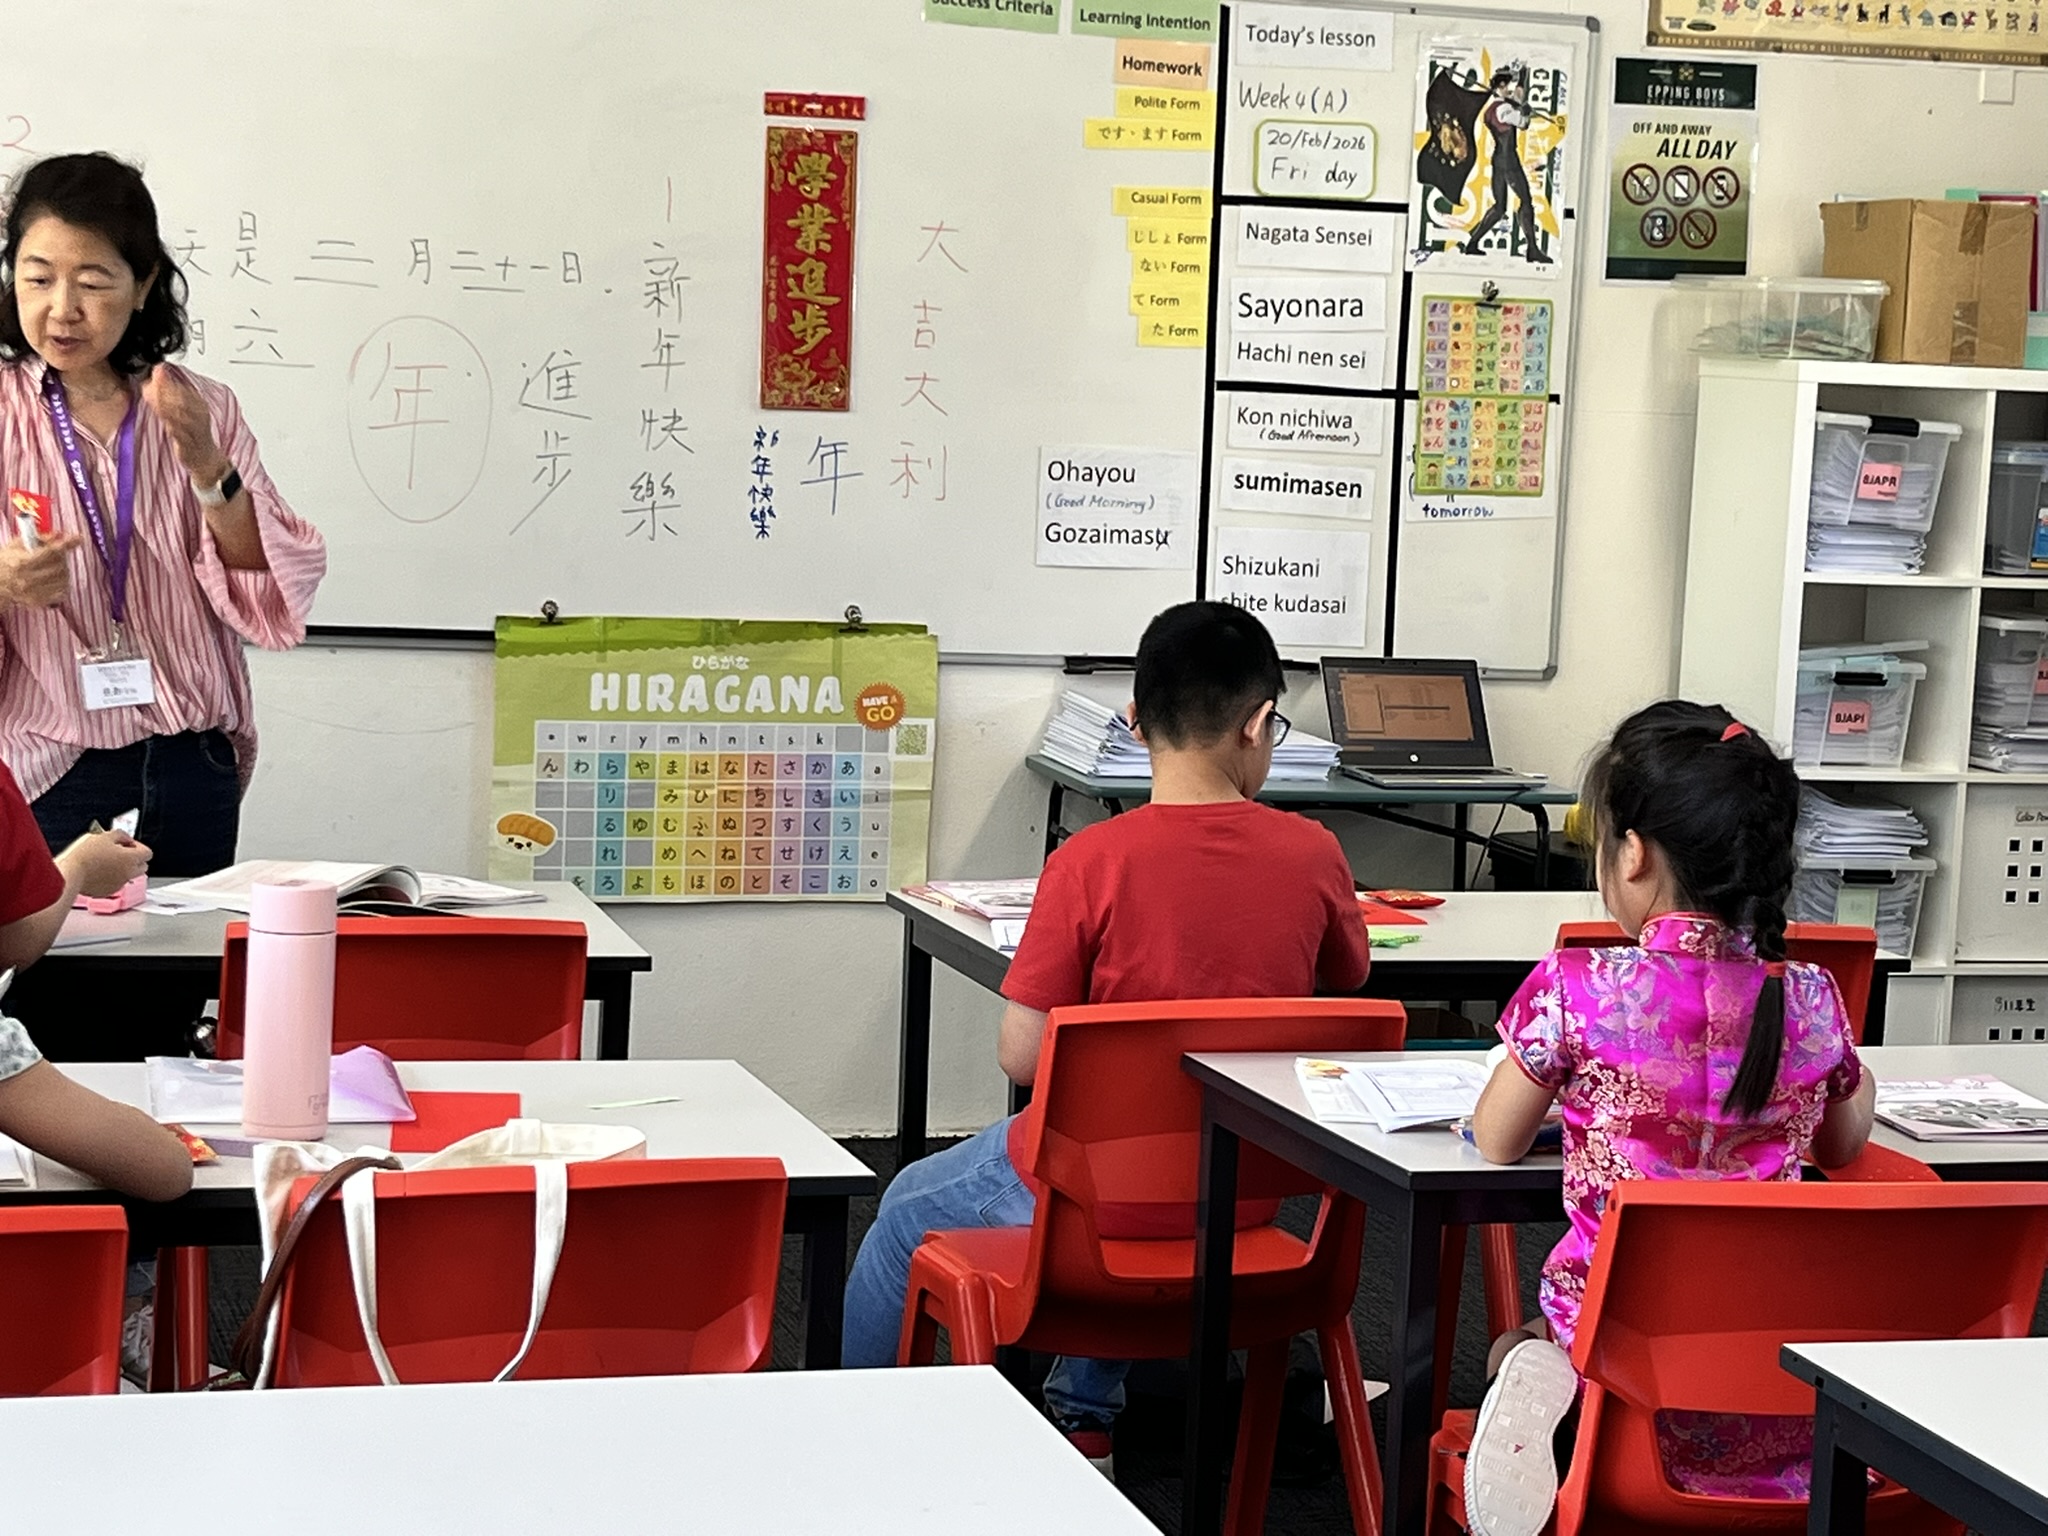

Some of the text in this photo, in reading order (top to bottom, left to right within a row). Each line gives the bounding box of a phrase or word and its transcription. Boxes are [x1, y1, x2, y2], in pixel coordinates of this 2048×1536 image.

[931, 0, 1054, 16] uccess Criteria
[1080, 9, 1210, 30] Learning Intention
[1246, 25, 1375, 47] Today's lesson
[1123, 56, 1202, 76] Homework
[1135, 96, 1200, 109] Polite Form
[1240, 81, 1289, 108] Week
[1296, 92, 1305, 109] 4
[1648, 84, 1725, 101] EPPING BOYS
[1099, 126, 1201, 140] です・ます Form
[1633, 122, 1713, 137] OFF AND AWAY
[1268, 130, 1365, 150] 20/Feb/2026
[1656, 138, 1738, 161] ALL DAY
[1272, 157, 1356, 188] Fri day
[1131, 192, 1201, 204] Casual Form
[1135, 231, 1207, 244] じしょ Form
[1247, 223, 1371, 245] Nagata Sensei
[787, 152, 841, 354] 學業進步
[1141, 258, 1200, 272] ない Form
[1134, 294, 1179, 306] て Form
[1239, 293, 1362, 324] Sayonara
[1154, 323, 1198, 336] た Form
[889, 220, 969, 502] 大吉大利
[1238, 342, 1365, 368] Hachi nen sei
[621, 241, 694, 541] 新年快樂
[370, 342, 450, 490] 年
[1238, 407, 1352, 431] Kon nichiwa
[509, 350, 592, 534] 進步
[747, 424, 780, 540] 新年快樂
[799, 435, 864, 516] 年
[1048, 460, 1135, 486] Ohayou
[1234, 472, 1361, 498] sumimasen
[1422, 503, 1494, 518] tomorrow
[1223, 555, 1319, 577] Shizukani
[1275, 593, 1347, 614] kudasai
[692, 655, 750, 670] ひらがな
[589, 673, 845, 714] HIRAGANA
[863, 697, 889, 707] HAVE
[866, 706, 896, 722] GO
[639, 737, 647, 748] y
[700, 733, 707, 744] h
[759, 735, 764, 744] t
[788, 737, 793, 745] s
[817, 733, 823, 744] k
[543, 759, 880, 775] ん わ ら や ま は な た さ か あ a
[606, 787, 879, 803] り み ひ に ち し き い i
[604, 818, 616, 832] る
[633, 818, 647, 832] ゆ
[663, 818, 677, 832] む
[693, 817, 708, 830] ふ
[722, 817, 736, 830] ぬ
[752, 818, 766, 830] つ
[782, 818, 795, 832] す
[813, 818, 820, 831] く
[842, 817, 851, 832] う
[602, 846, 878, 861] れ め へ ね て せ け え e
[602, 876, 614, 890] ろ
[632, 876, 643, 890] よ
[663, 875, 674, 890] も
[691, 875, 705, 889] ほ
[721, 876, 734, 889] の
[752, 875, 762, 889] と
[780, 875, 792, 889] そ
[809, 875, 821, 888] こ
[838, 875, 851, 888] お
